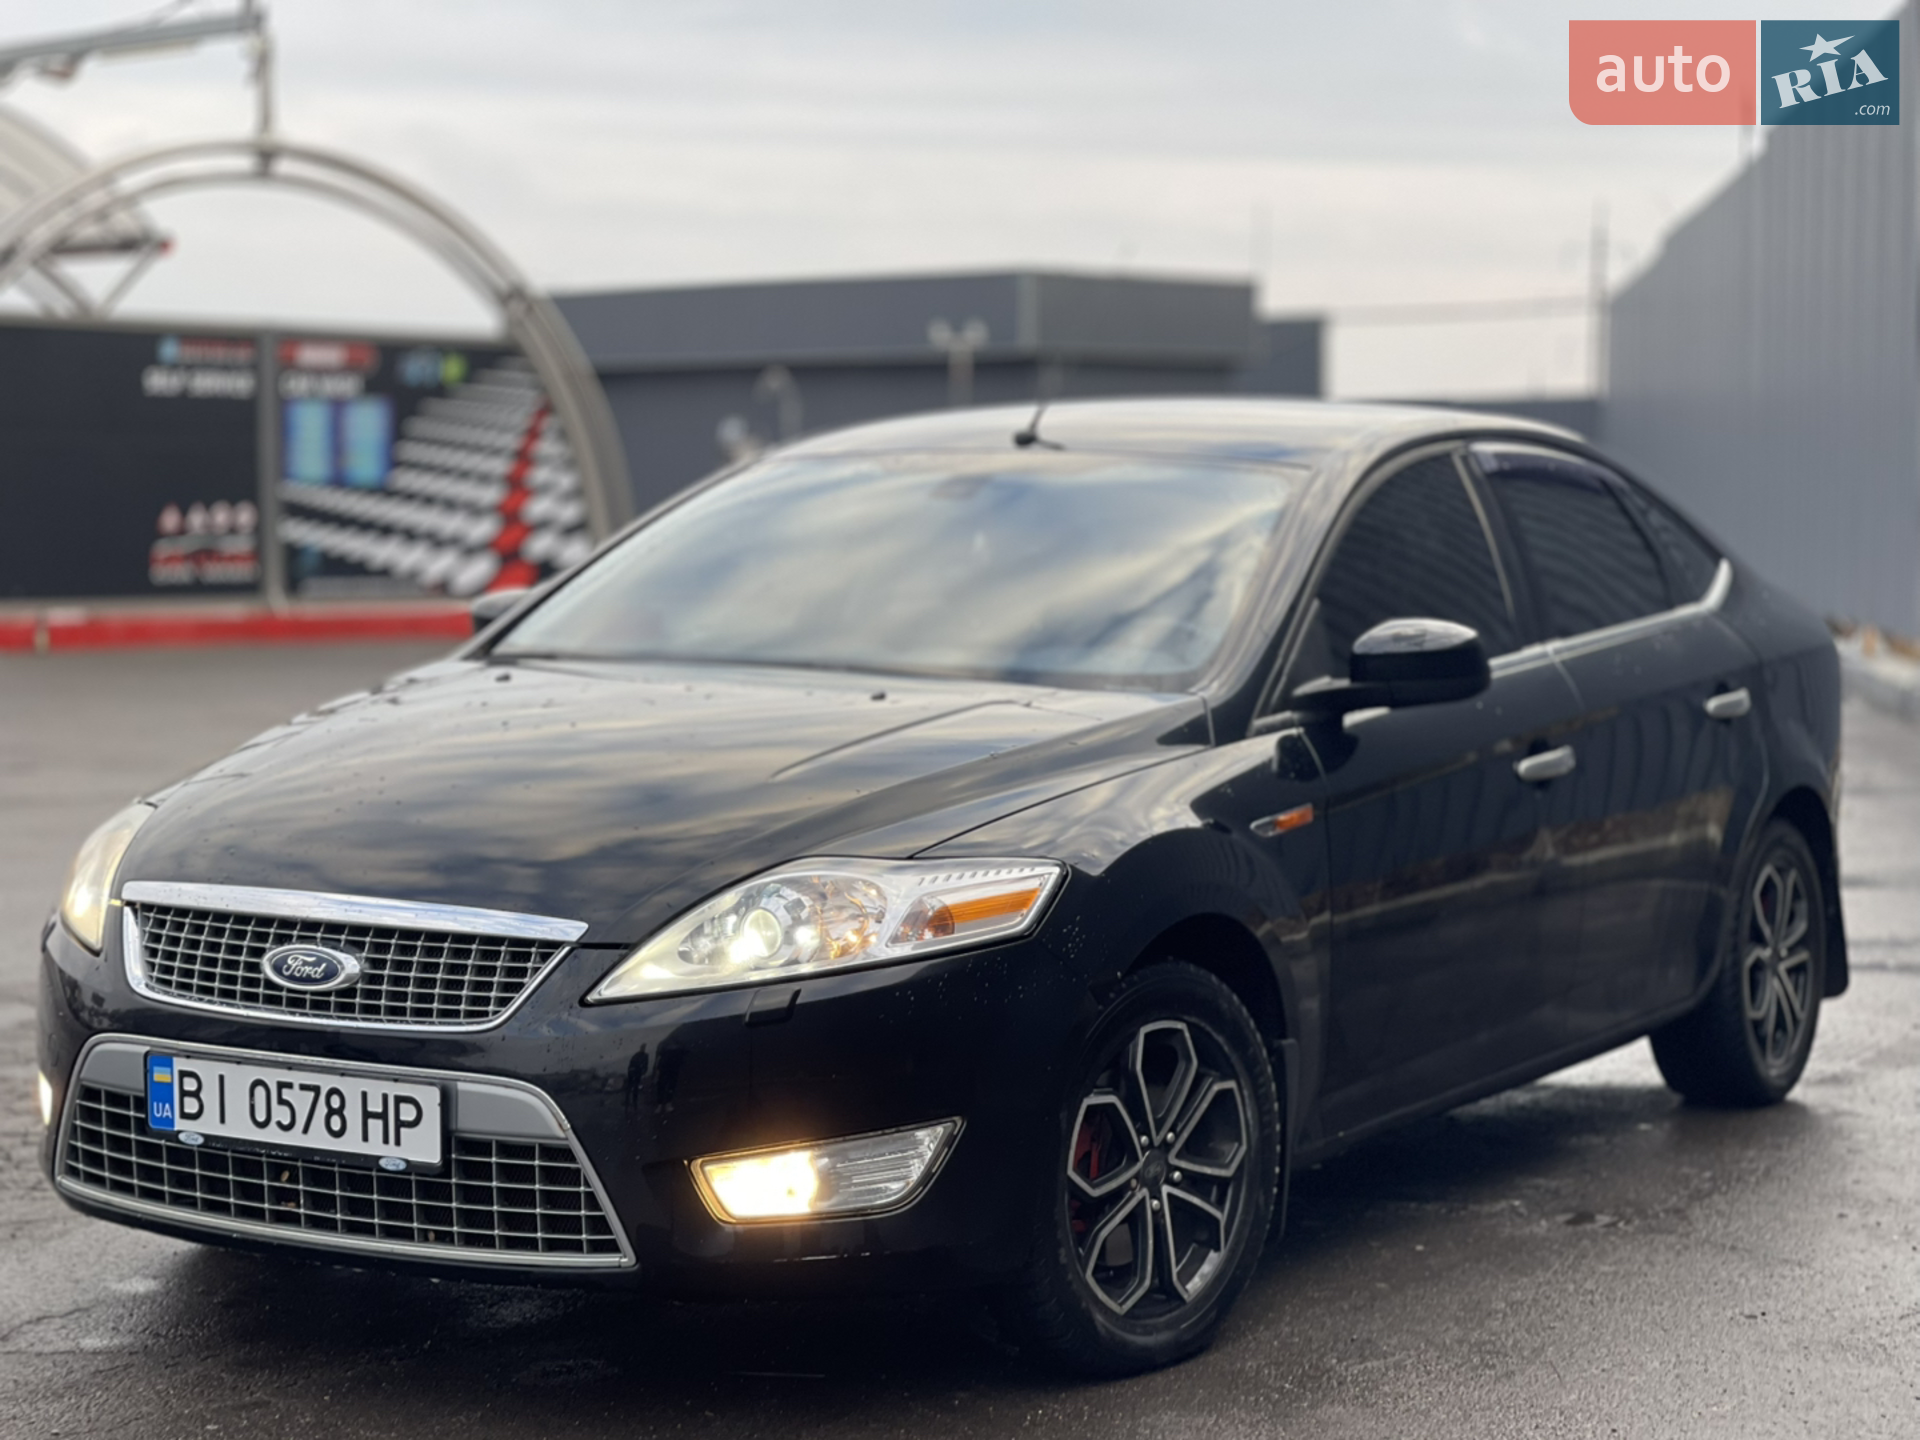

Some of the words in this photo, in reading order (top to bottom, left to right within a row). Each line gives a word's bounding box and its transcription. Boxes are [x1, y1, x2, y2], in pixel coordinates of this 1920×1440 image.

[282, 954, 327, 979] Ford
[153, 1102, 172, 1119] UA
[178, 1069, 226, 1125] BI
[248, 1078, 348, 1139] 0578
[360, 1090, 424, 1147] HP
